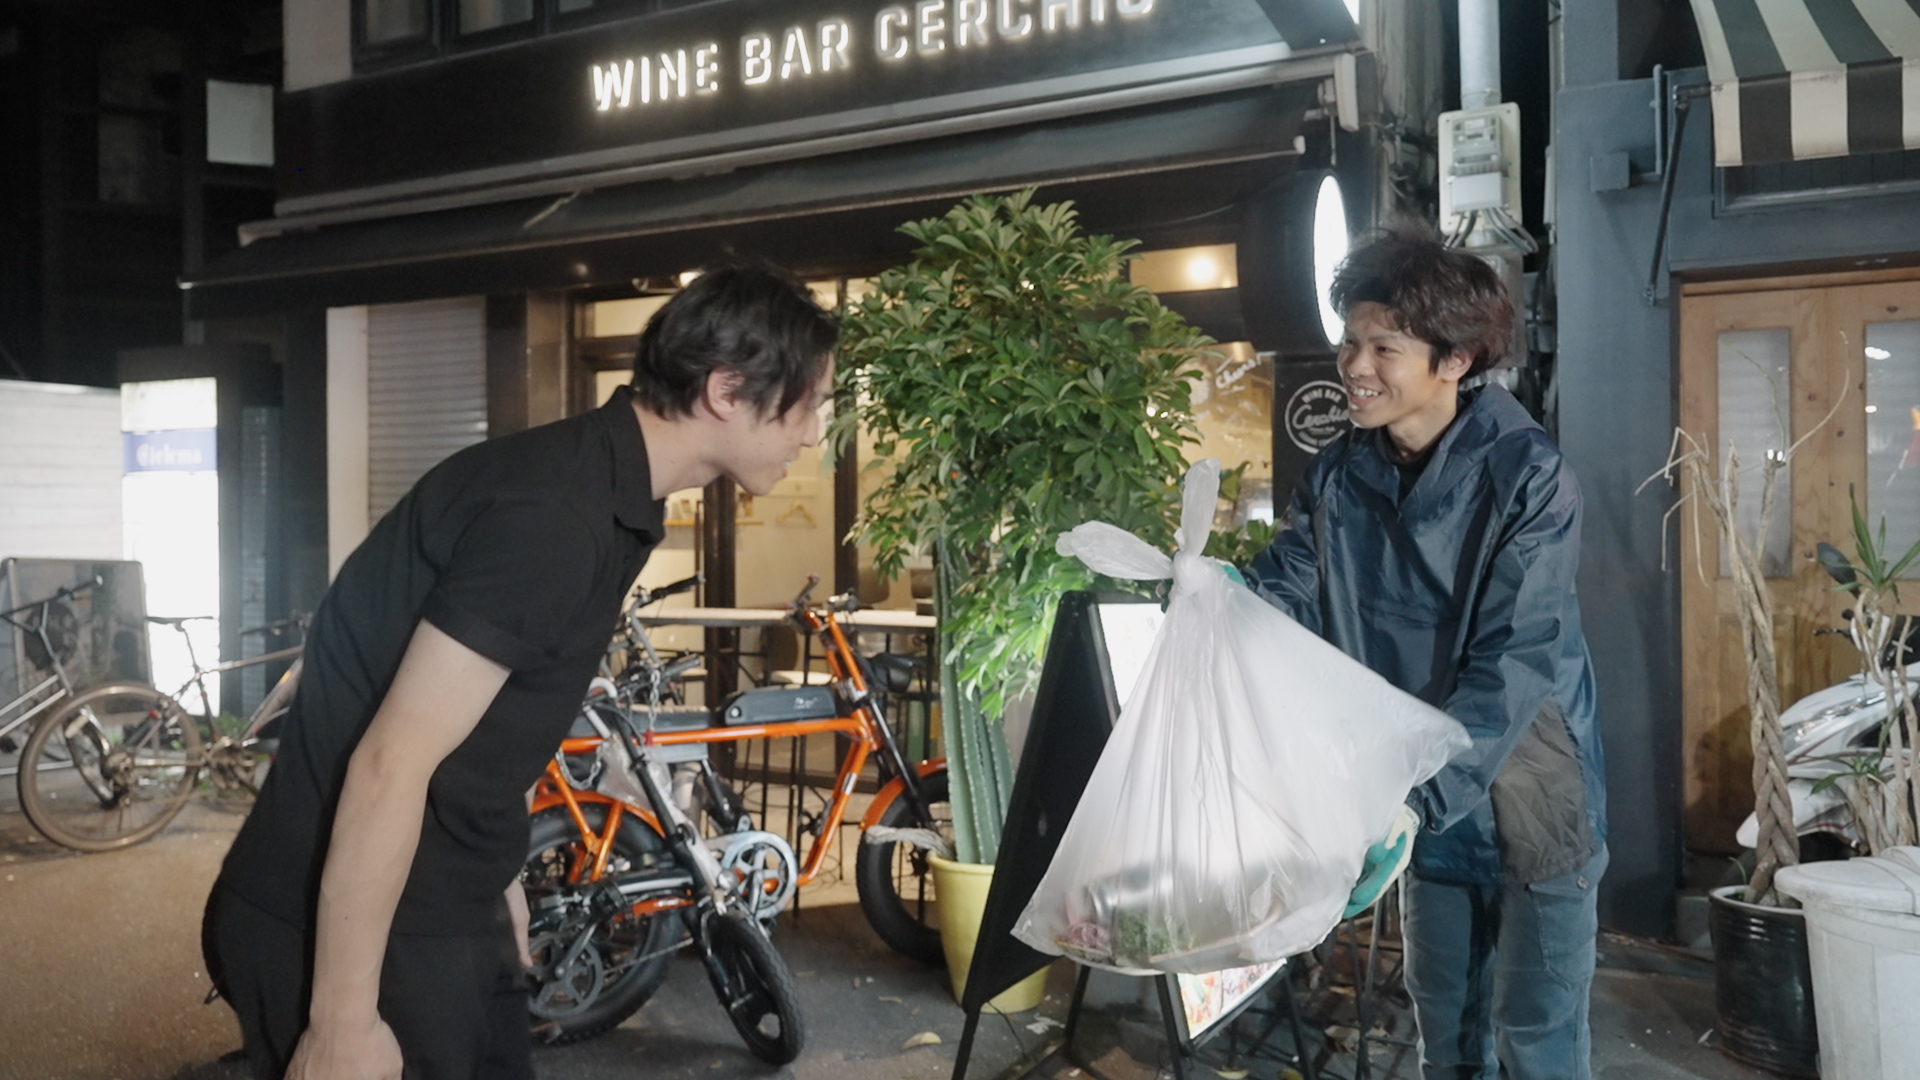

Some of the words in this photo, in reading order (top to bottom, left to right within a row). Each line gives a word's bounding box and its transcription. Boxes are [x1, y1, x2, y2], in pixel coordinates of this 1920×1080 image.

[588, 42, 719, 110] WINE
[740, 18, 849, 86] BAR
[1301, 387, 1323, 403] WINE
[1324, 388, 1342, 403] BAR
